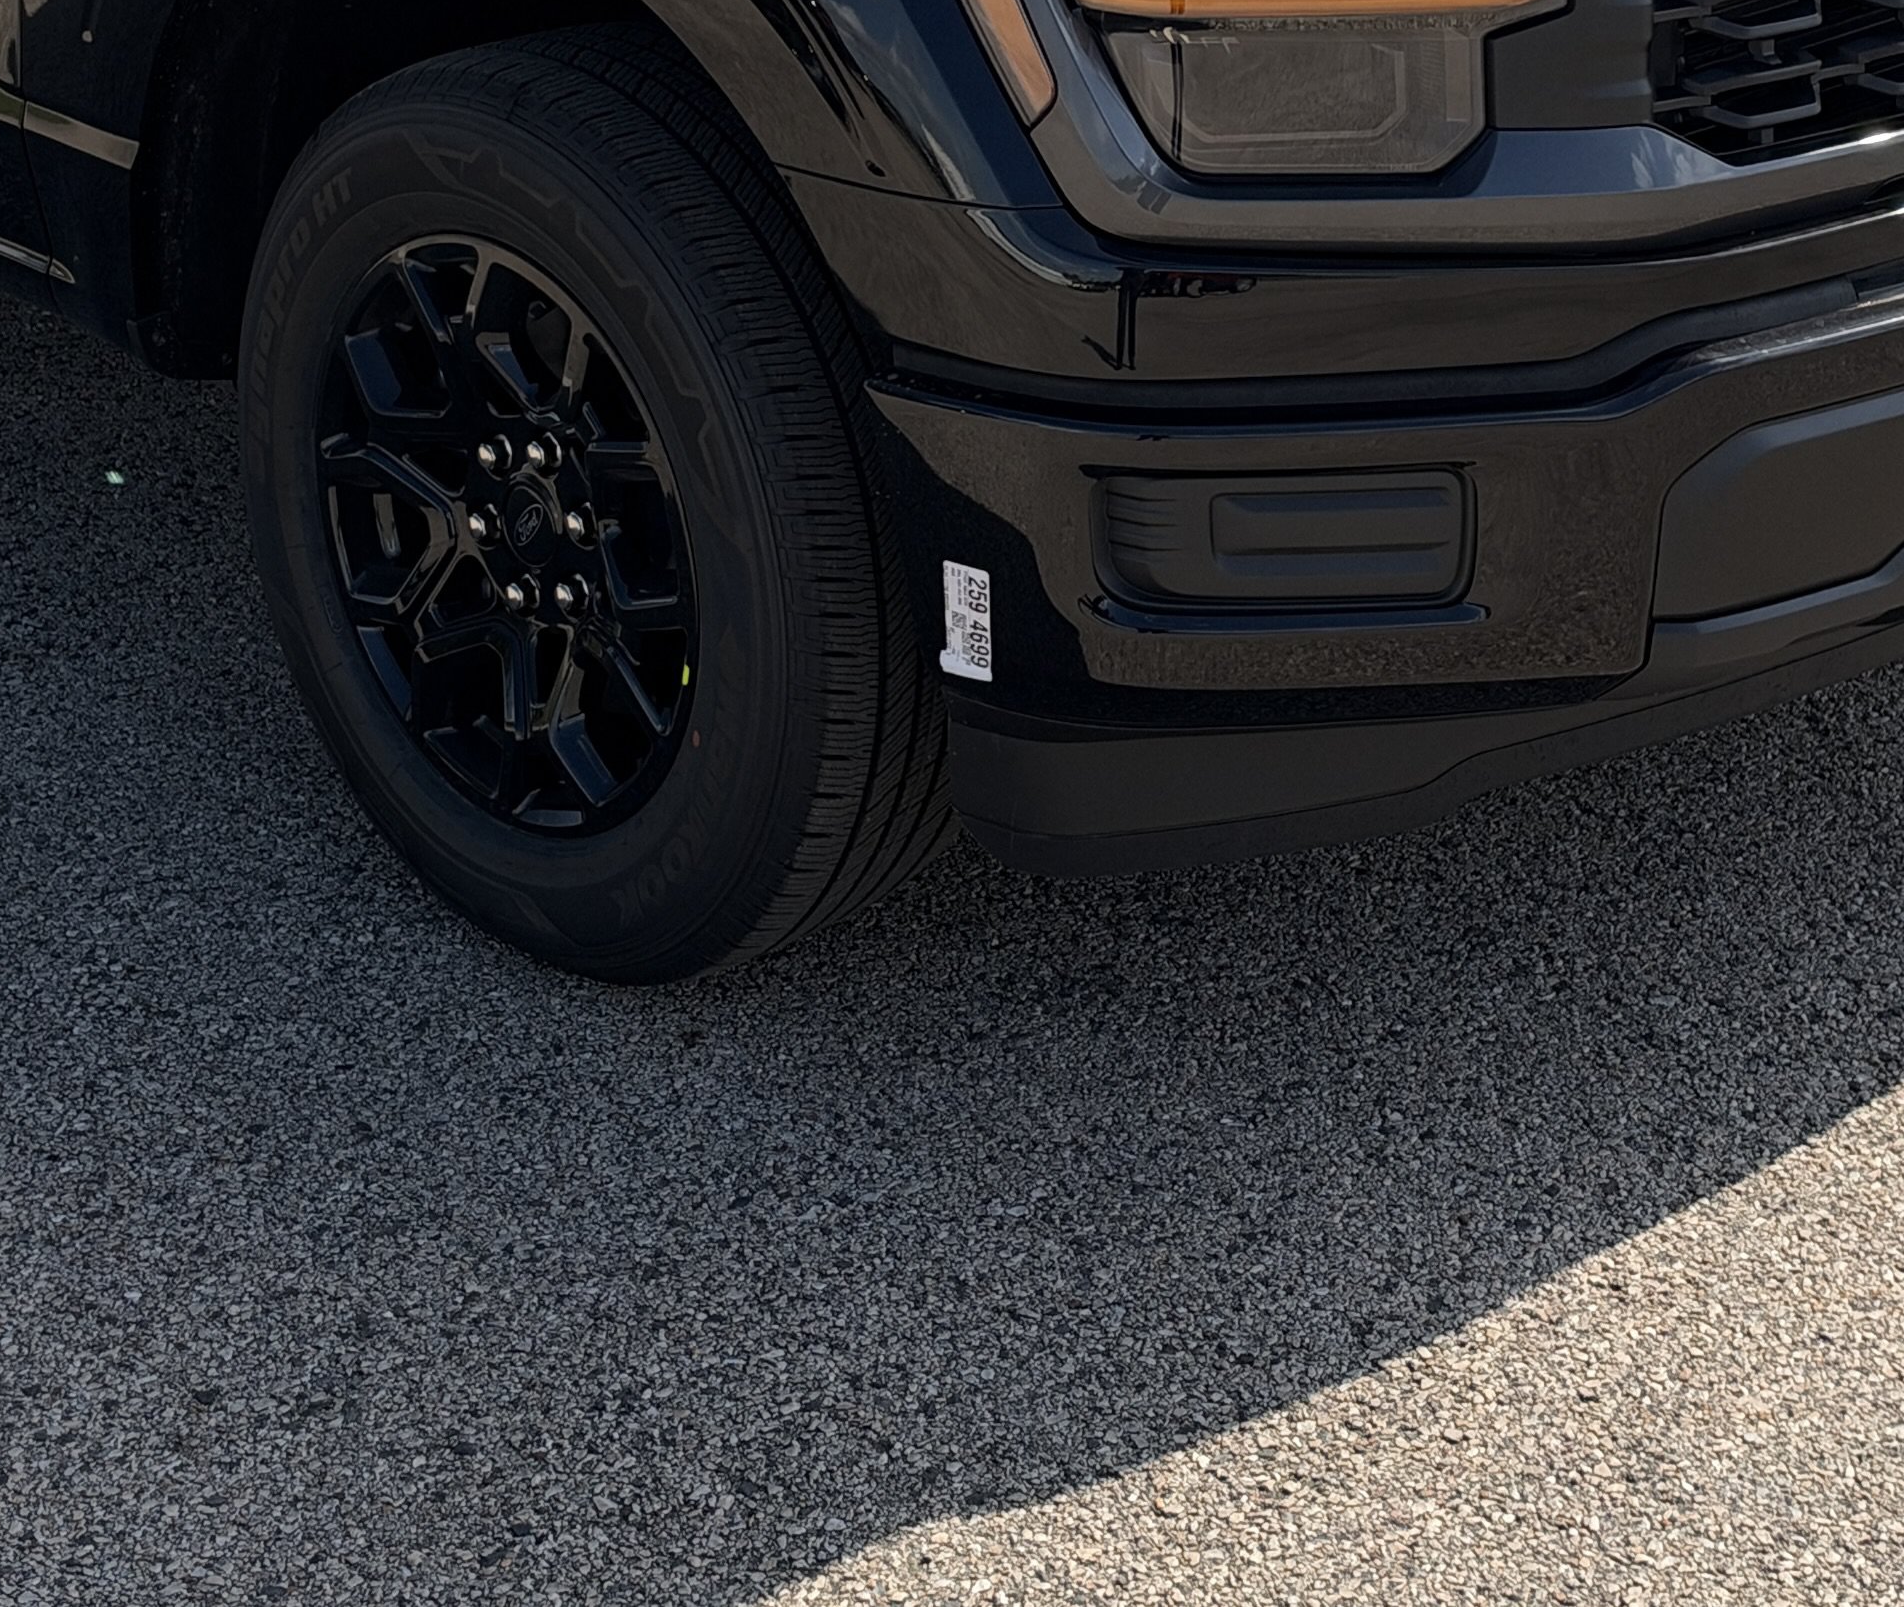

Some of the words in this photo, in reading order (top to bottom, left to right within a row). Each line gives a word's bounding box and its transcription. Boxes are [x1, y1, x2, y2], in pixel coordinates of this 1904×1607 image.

[311, 166, 354, 228] HT
[517, 509, 539, 542] Ford
[967, 576, 989, 615] 259
[969, 619, 990, 669] 4699
